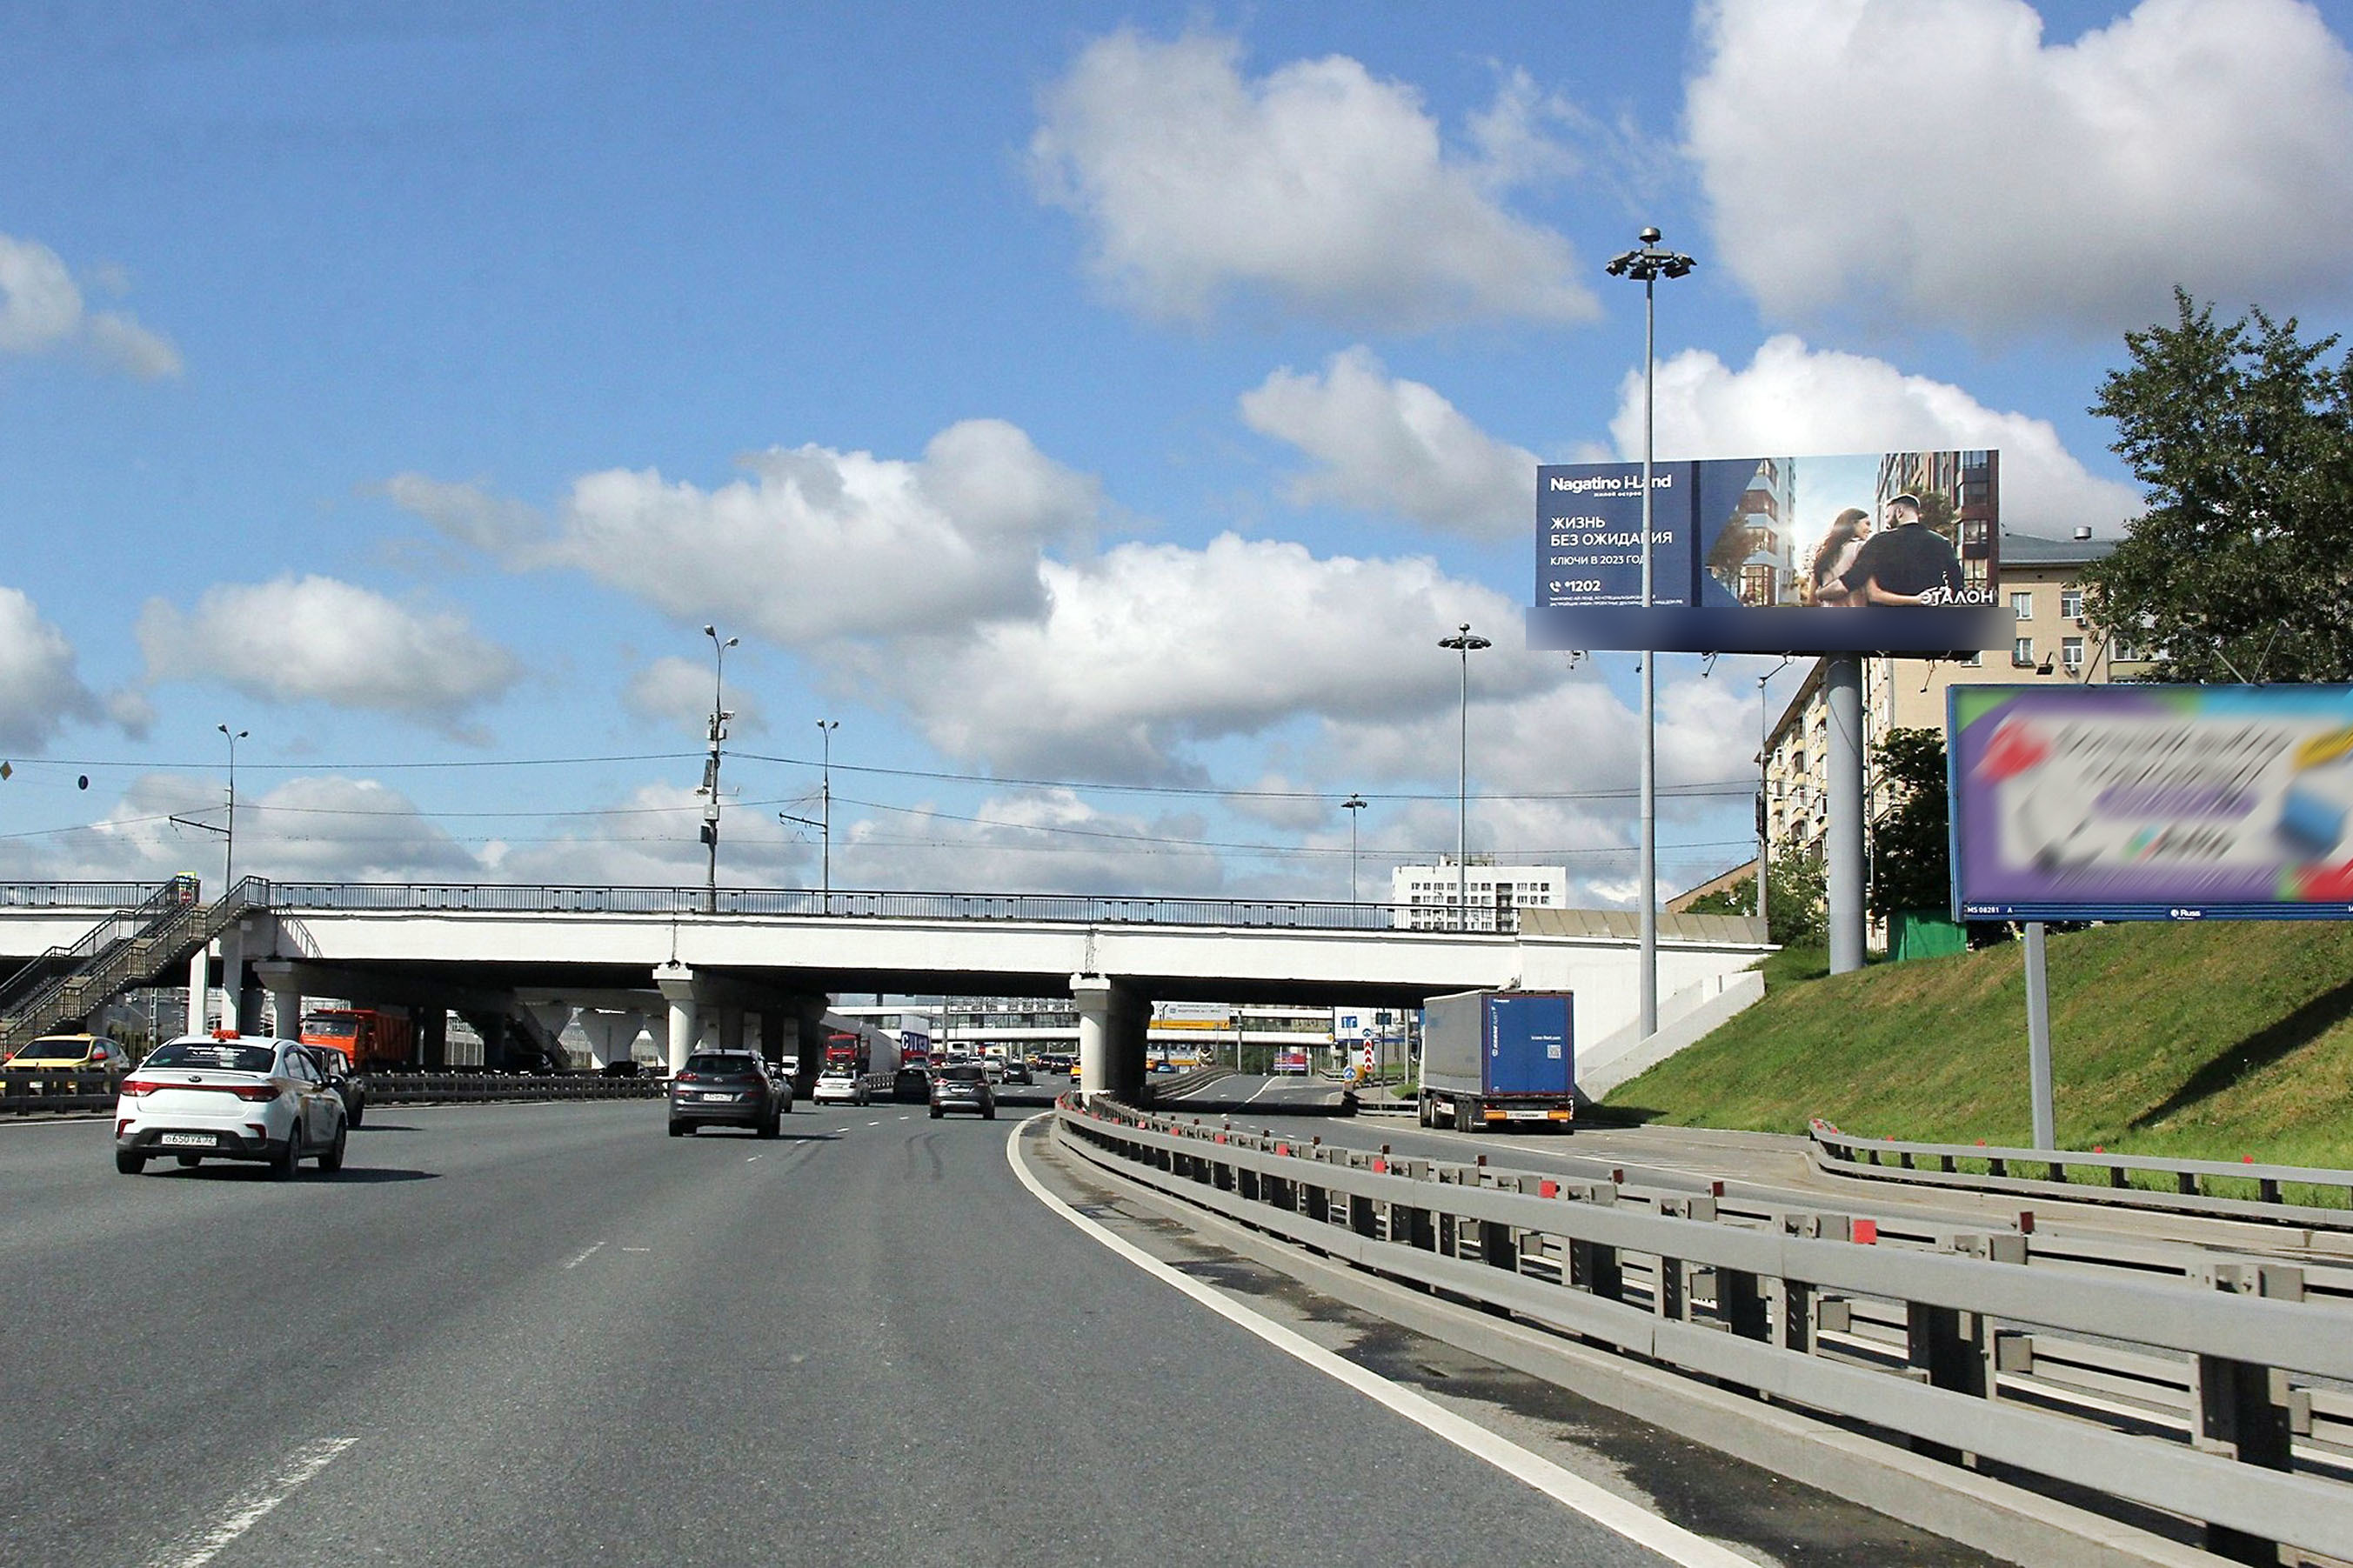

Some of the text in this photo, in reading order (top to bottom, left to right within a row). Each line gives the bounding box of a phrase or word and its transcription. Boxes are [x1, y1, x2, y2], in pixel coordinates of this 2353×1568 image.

[1550, 475, 1621, 494] Nagatino
[1550, 516, 1606, 530] ЖИЗНЬ
[1550, 533, 1579, 547] БЕЗ
[1550, 556, 1588, 566] КЛЮЧИ
[1590, 556, 1598, 564] В
[1600, 555, 1624, 564] 2023
